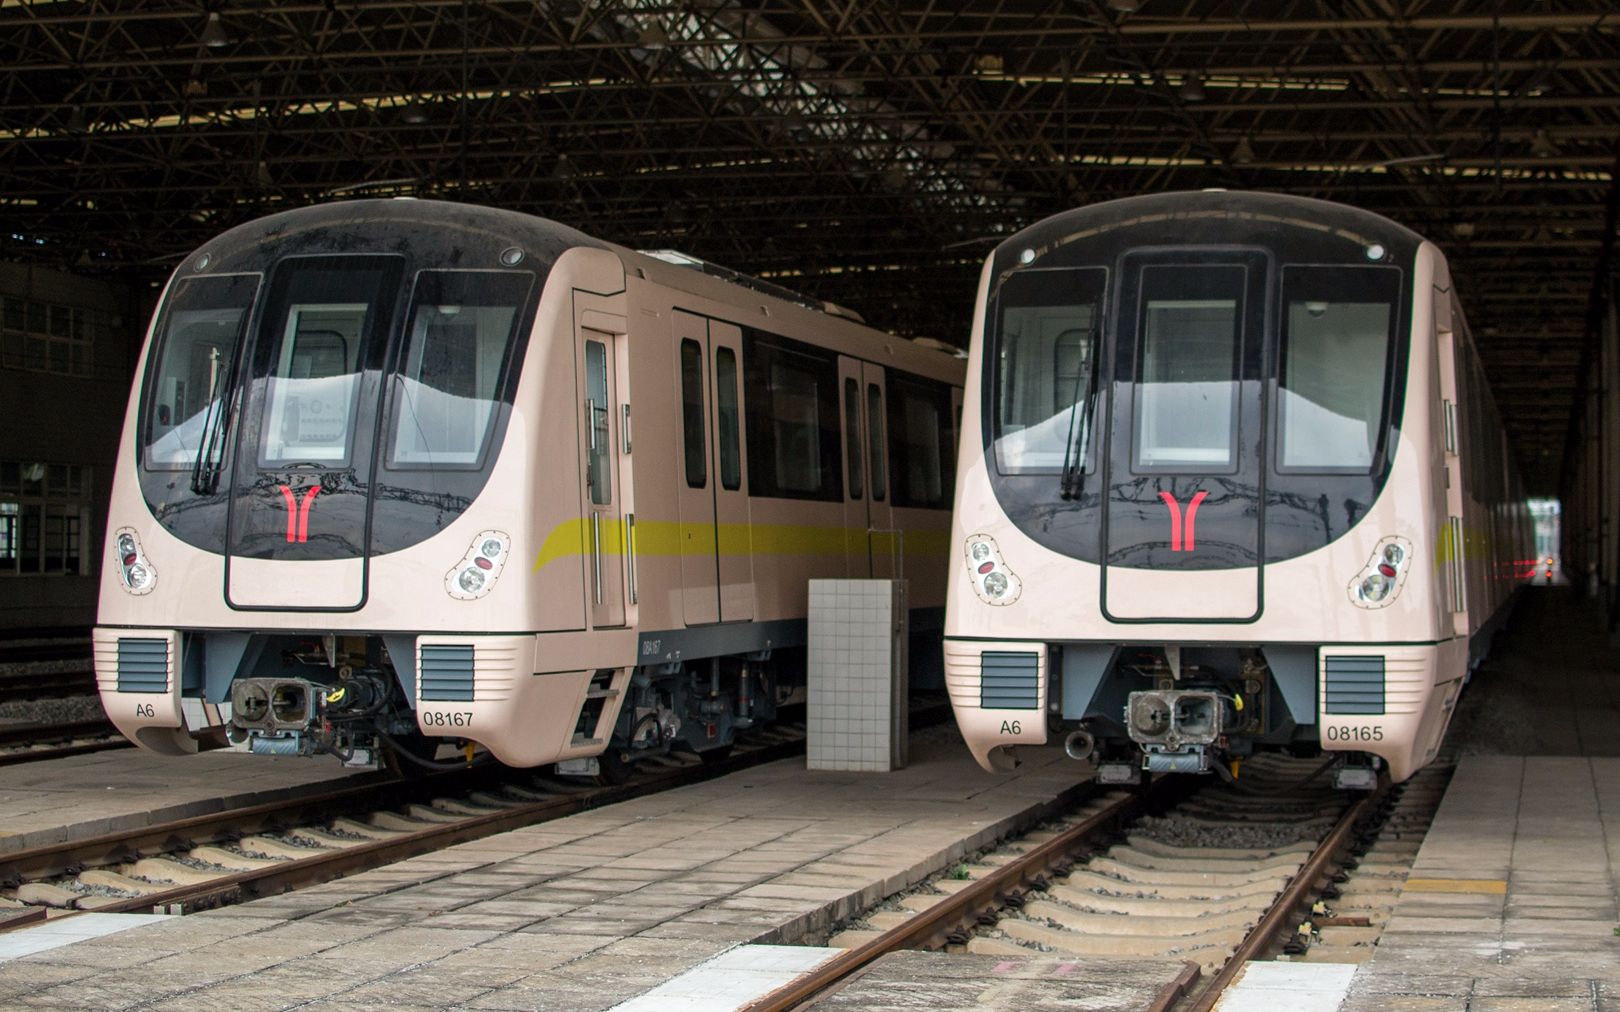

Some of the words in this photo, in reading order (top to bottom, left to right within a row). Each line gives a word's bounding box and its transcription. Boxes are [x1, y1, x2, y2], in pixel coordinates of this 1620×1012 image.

[136, 703, 155, 718] A6
[423, 711, 474, 727] 08167
[1000, 719, 1022, 735] A6
[1327, 725, 1384, 741] 08165
